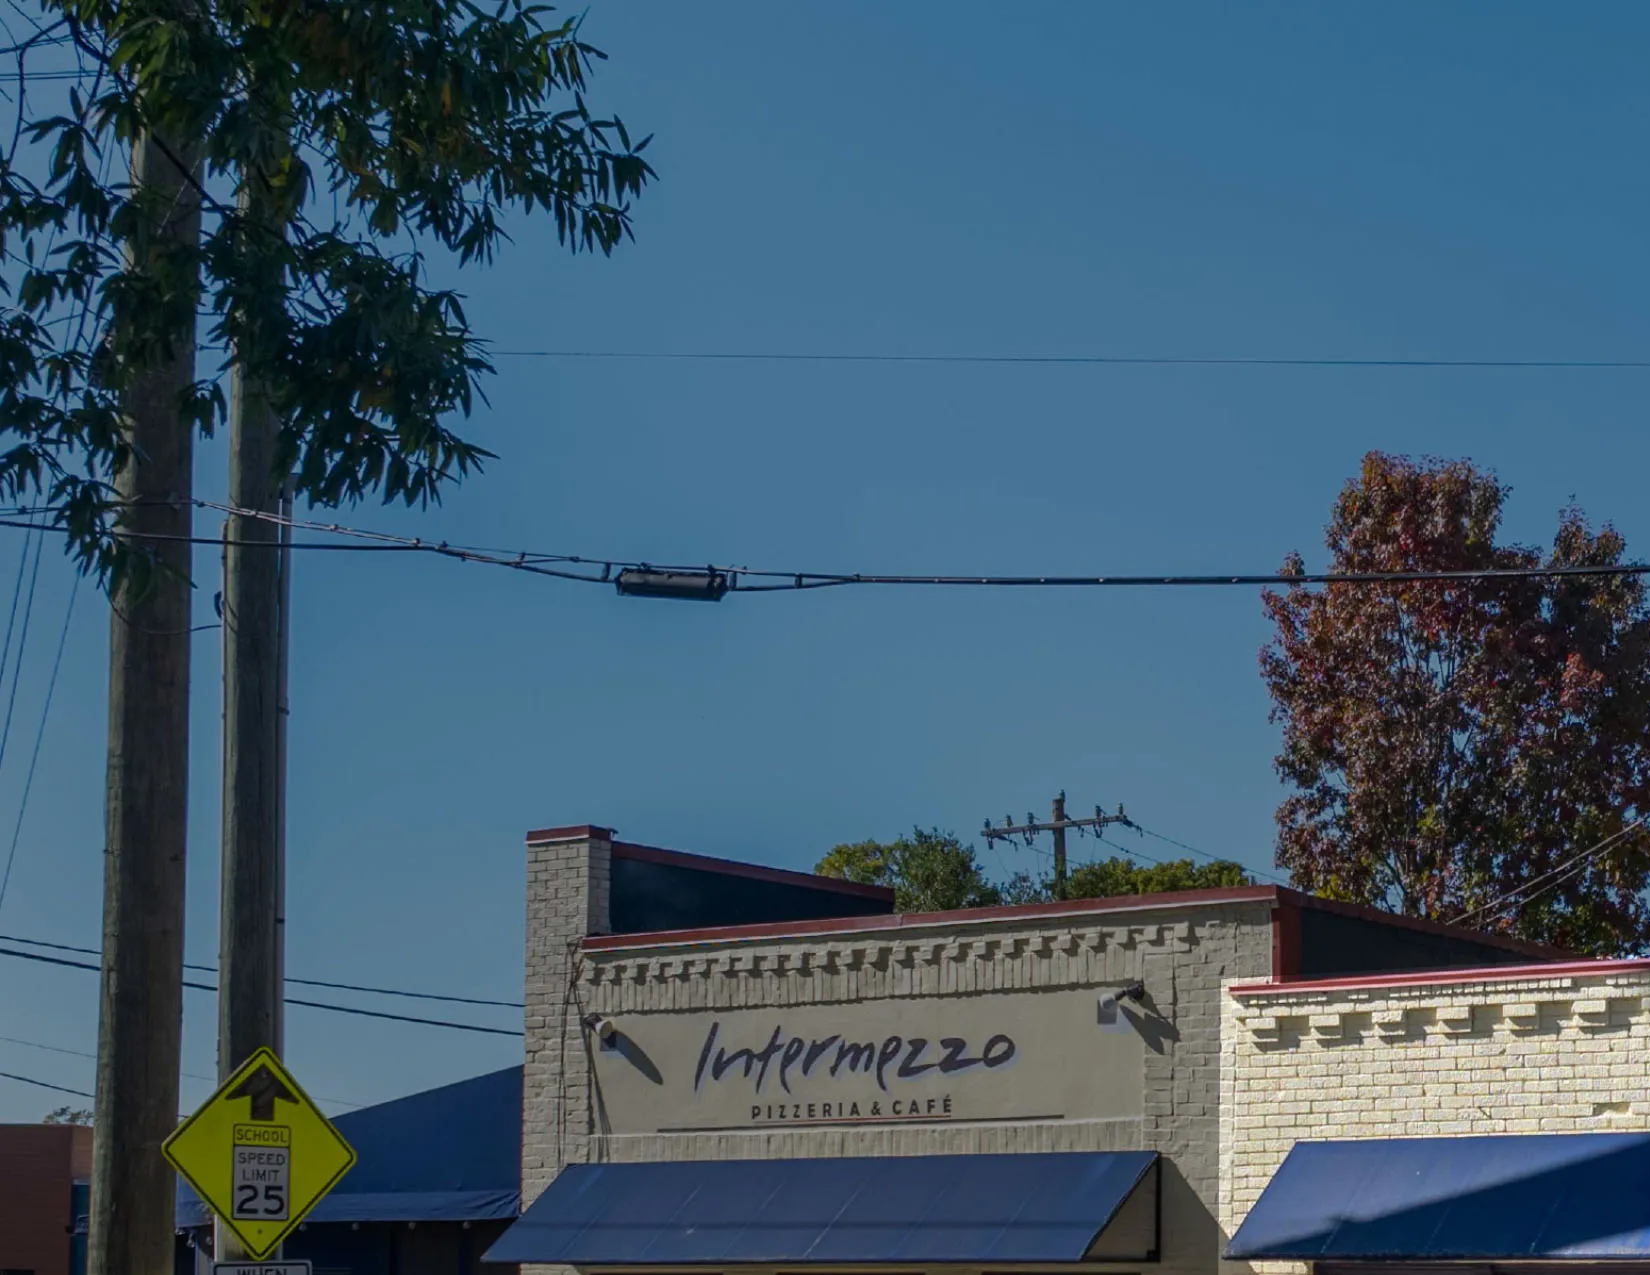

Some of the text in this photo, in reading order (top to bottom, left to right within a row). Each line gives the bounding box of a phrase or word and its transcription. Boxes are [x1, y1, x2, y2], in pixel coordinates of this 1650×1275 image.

[694, 1021, 1016, 1095] Intermezzo
[751, 1094, 953, 1121] PIZZERIA & CAFÉ
[236, 1128, 288, 1143] SCHOOL
[238, 1152, 286, 1166] SPEED
[242, 1168, 281, 1182] LIMIT
[236, 1184, 286, 1215] 25
